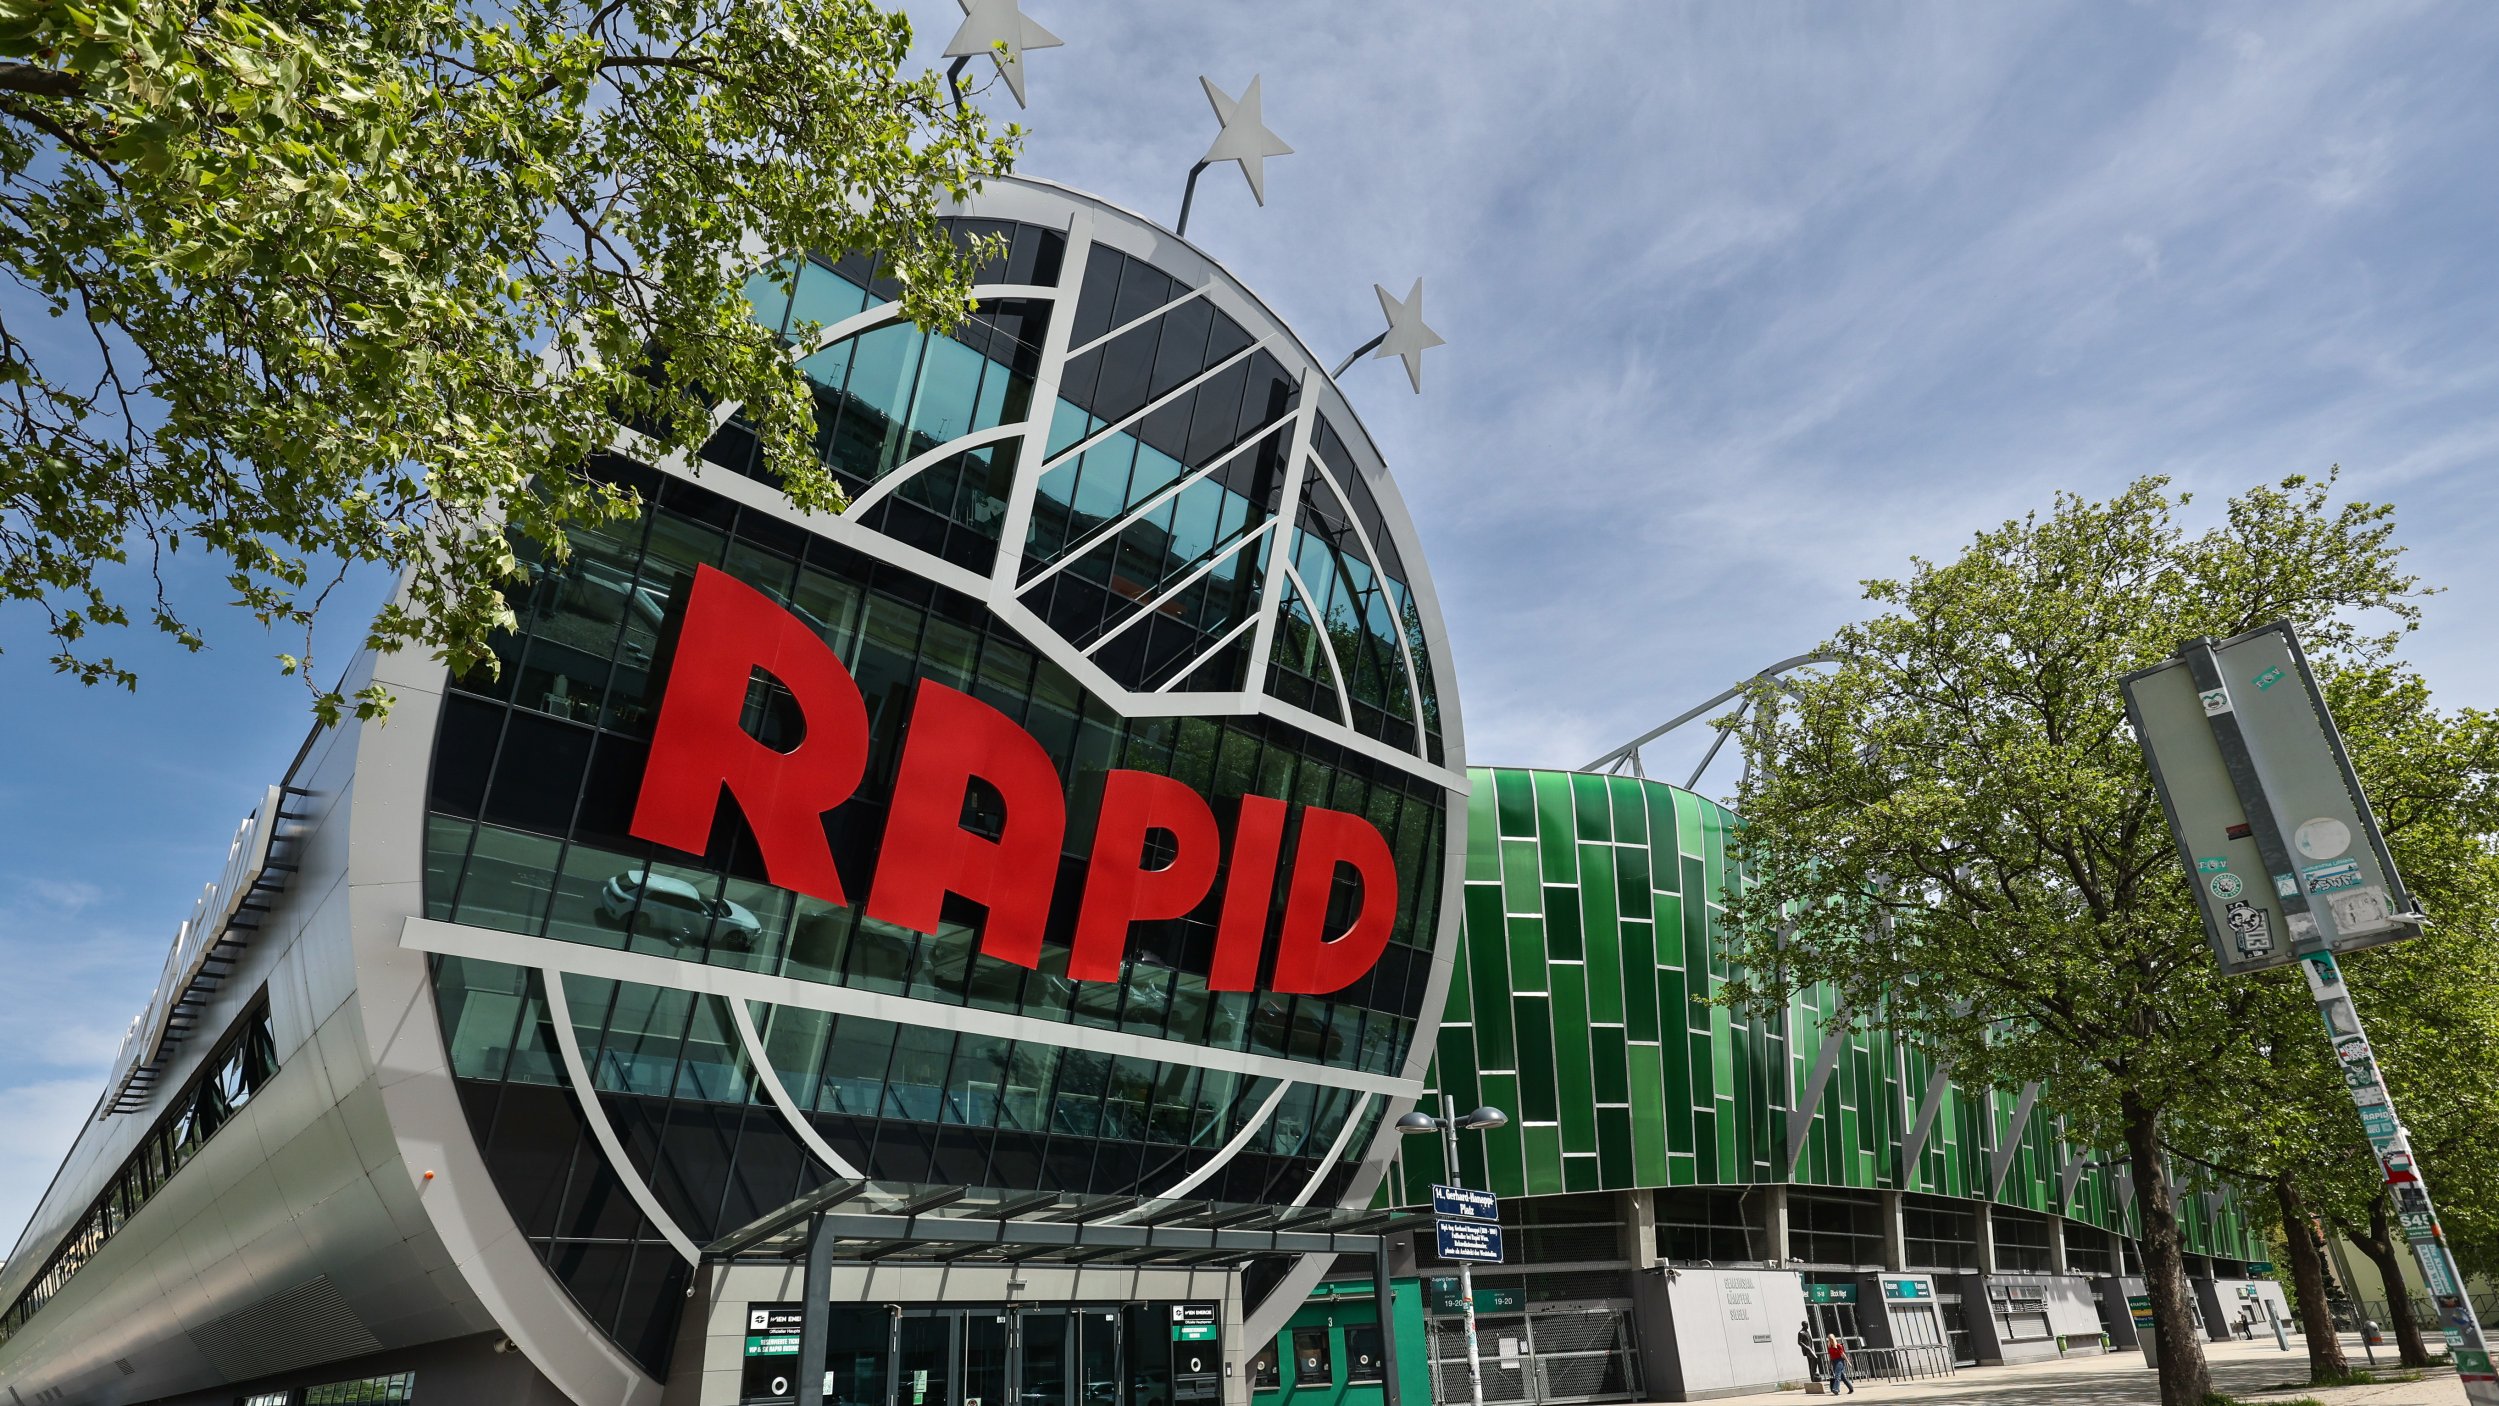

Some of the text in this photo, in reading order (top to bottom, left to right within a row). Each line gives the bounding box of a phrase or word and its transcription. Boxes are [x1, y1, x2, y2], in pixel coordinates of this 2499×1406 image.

[630, 563, 1399, 996] RAPID
[2363, 1110, 2389, 1121] RAPID
[1459, 1203, 1475, 1216] Platz
[2420, 1245, 2434, 1272] RAPID
[2431, 1273, 2444, 1295] WIEN
[1327, 1316, 1333, 1328] 3
